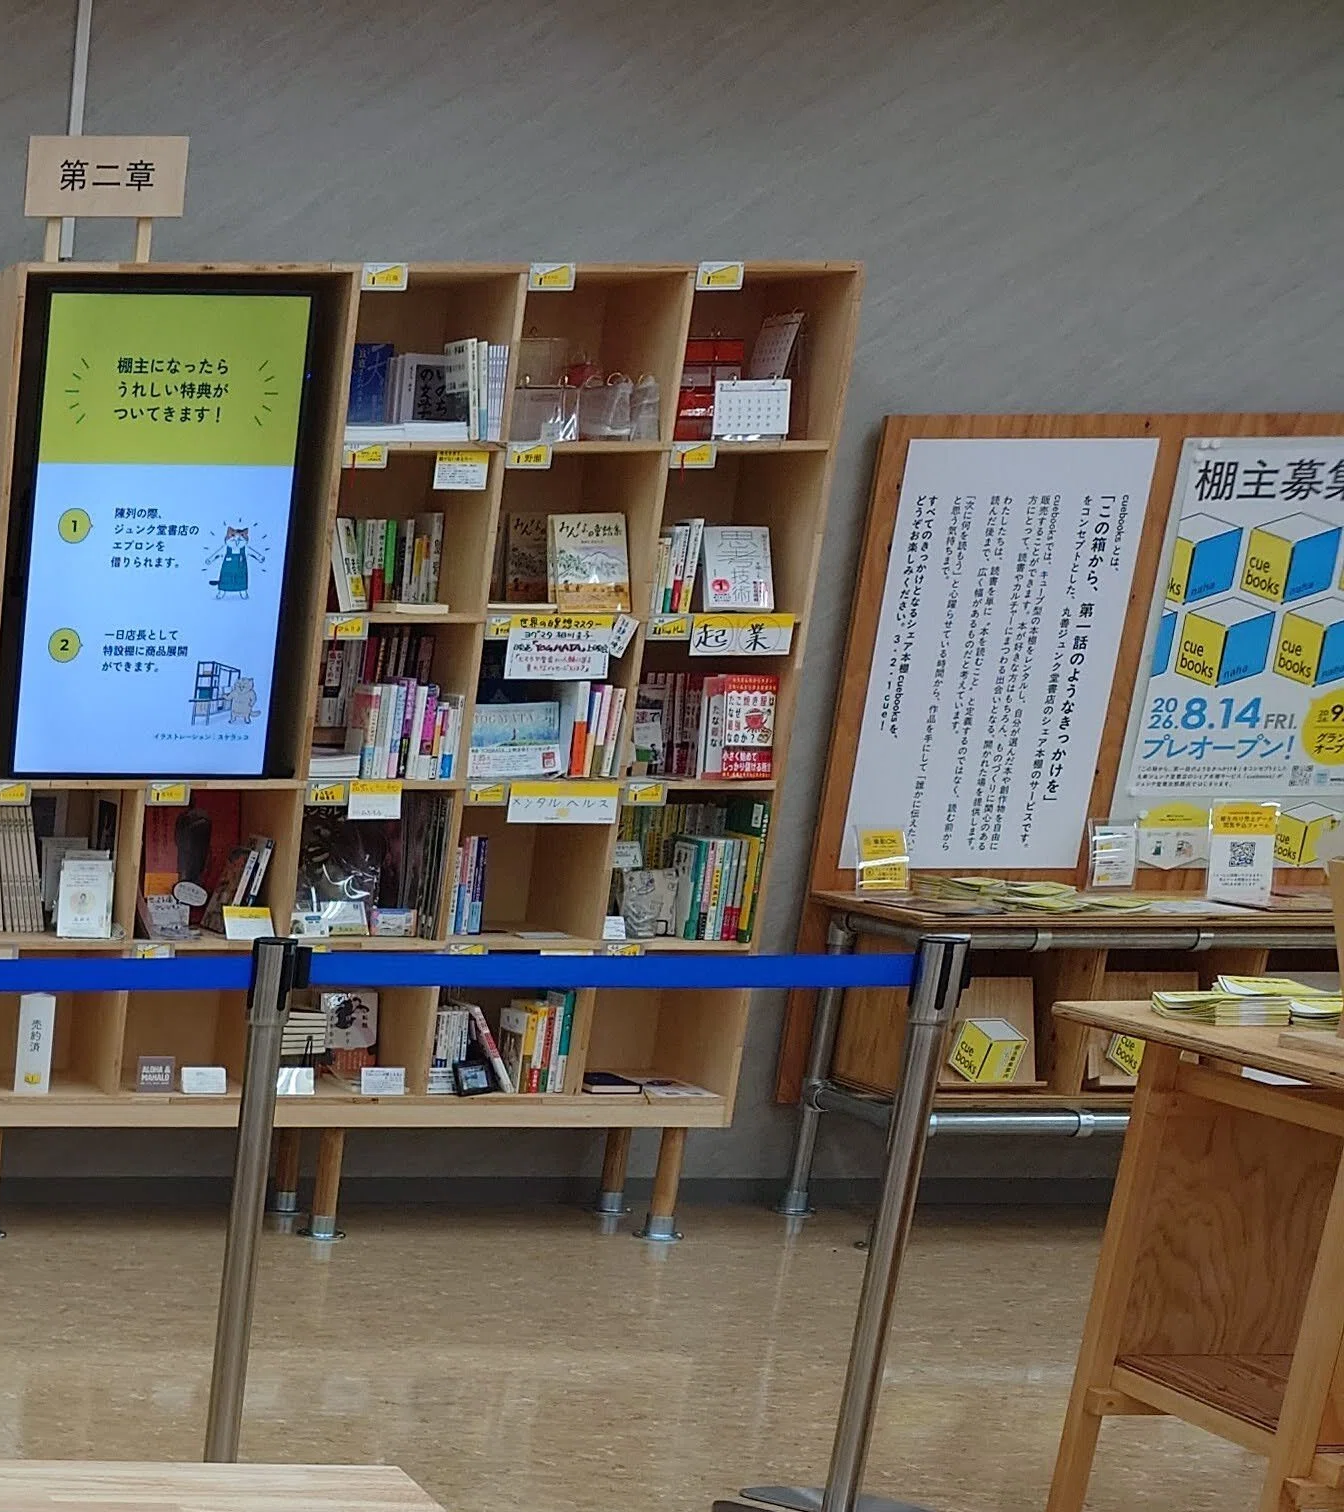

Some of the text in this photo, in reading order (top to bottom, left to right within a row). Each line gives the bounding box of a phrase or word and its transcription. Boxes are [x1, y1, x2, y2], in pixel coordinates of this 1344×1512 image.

[60, 158, 155, 191] 第二章
[117, 357, 229, 374] 棚主になったら
[117, 383, 229, 399] うれしい特典が
[113, 406, 221, 423] ついてきます！
[114, 507, 162, 519] 陳列の際、
[70, 519, 79, 533] 1
[114, 523, 199, 536] ジュンク堂書店の
[112, 540, 165, 552] エプロンを
[110, 556, 180, 568] 借りられます。
[717, 530, 758, 603] 思考技術
[1249, 556, 1270, 573] cue
[1245, 570, 1280, 596] books
[104, 629, 179, 641] 一日店長として
[695, 623, 771, 651] 起業
[59, 639, 69, 651] 2
[102, 645, 188, 657] 特設棚に商品展開
[1043, 494, 1117, 802] 「この箱から、第一話のようなきっかけを」
[1183, 639, 1204, 655] cue
[1281, 639, 1302, 655] cue
[101, 661, 160, 673] ができます。
[1179, 654, 1214, 679] books
[1223, 665, 1248, 679] naha
[1278, 654, 1312, 679] books
[1152, 697, 1178, 713] 20
[1181, 697, 1262, 730] 8.14
[1263, 713, 1298, 730] FRI.
[1142, 733, 1296, 760] プレオープン！
[513, 798, 609, 809] メンタルヘルス
[30, 1019, 43, 1053] 売約済
[1120, 1033, 1136, 1052] cue
[959, 1041, 975, 1058] cue
[955, 1052, 978, 1076] books
[1115, 1046, 1139, 1071] books
[141, 1065, 163, 1074] ALOHA
